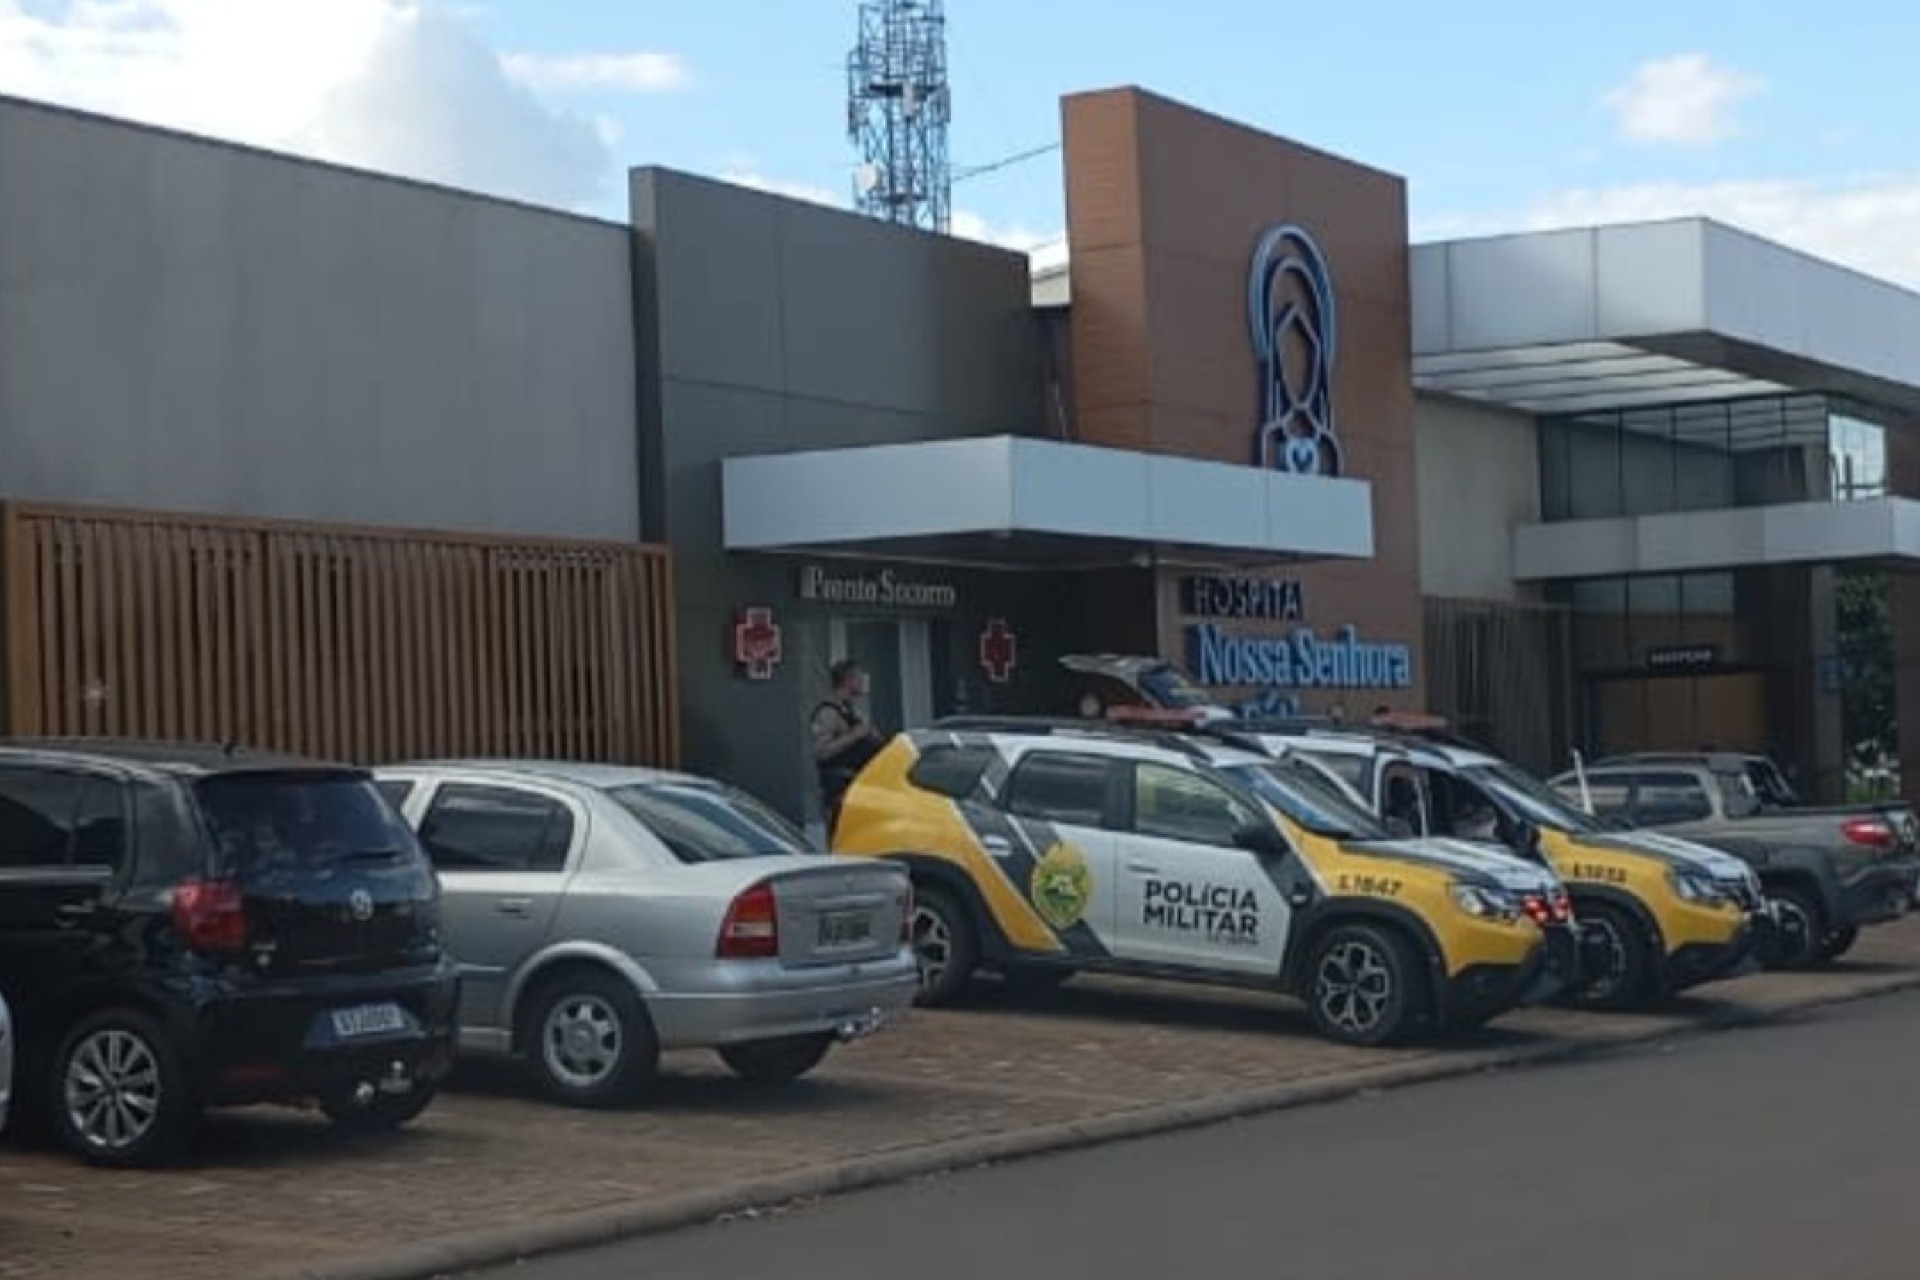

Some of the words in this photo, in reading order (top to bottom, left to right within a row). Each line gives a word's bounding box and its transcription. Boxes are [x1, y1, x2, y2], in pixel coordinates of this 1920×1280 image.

[801, 565, 878, 602] Pronto
[880, 568, 956, 606] Socorro
[1190, 623, 1294, 685] Nossa
[1298, 623, 1412, 688] Senhora
[1143, 904, 1258, 936] MILITAR
